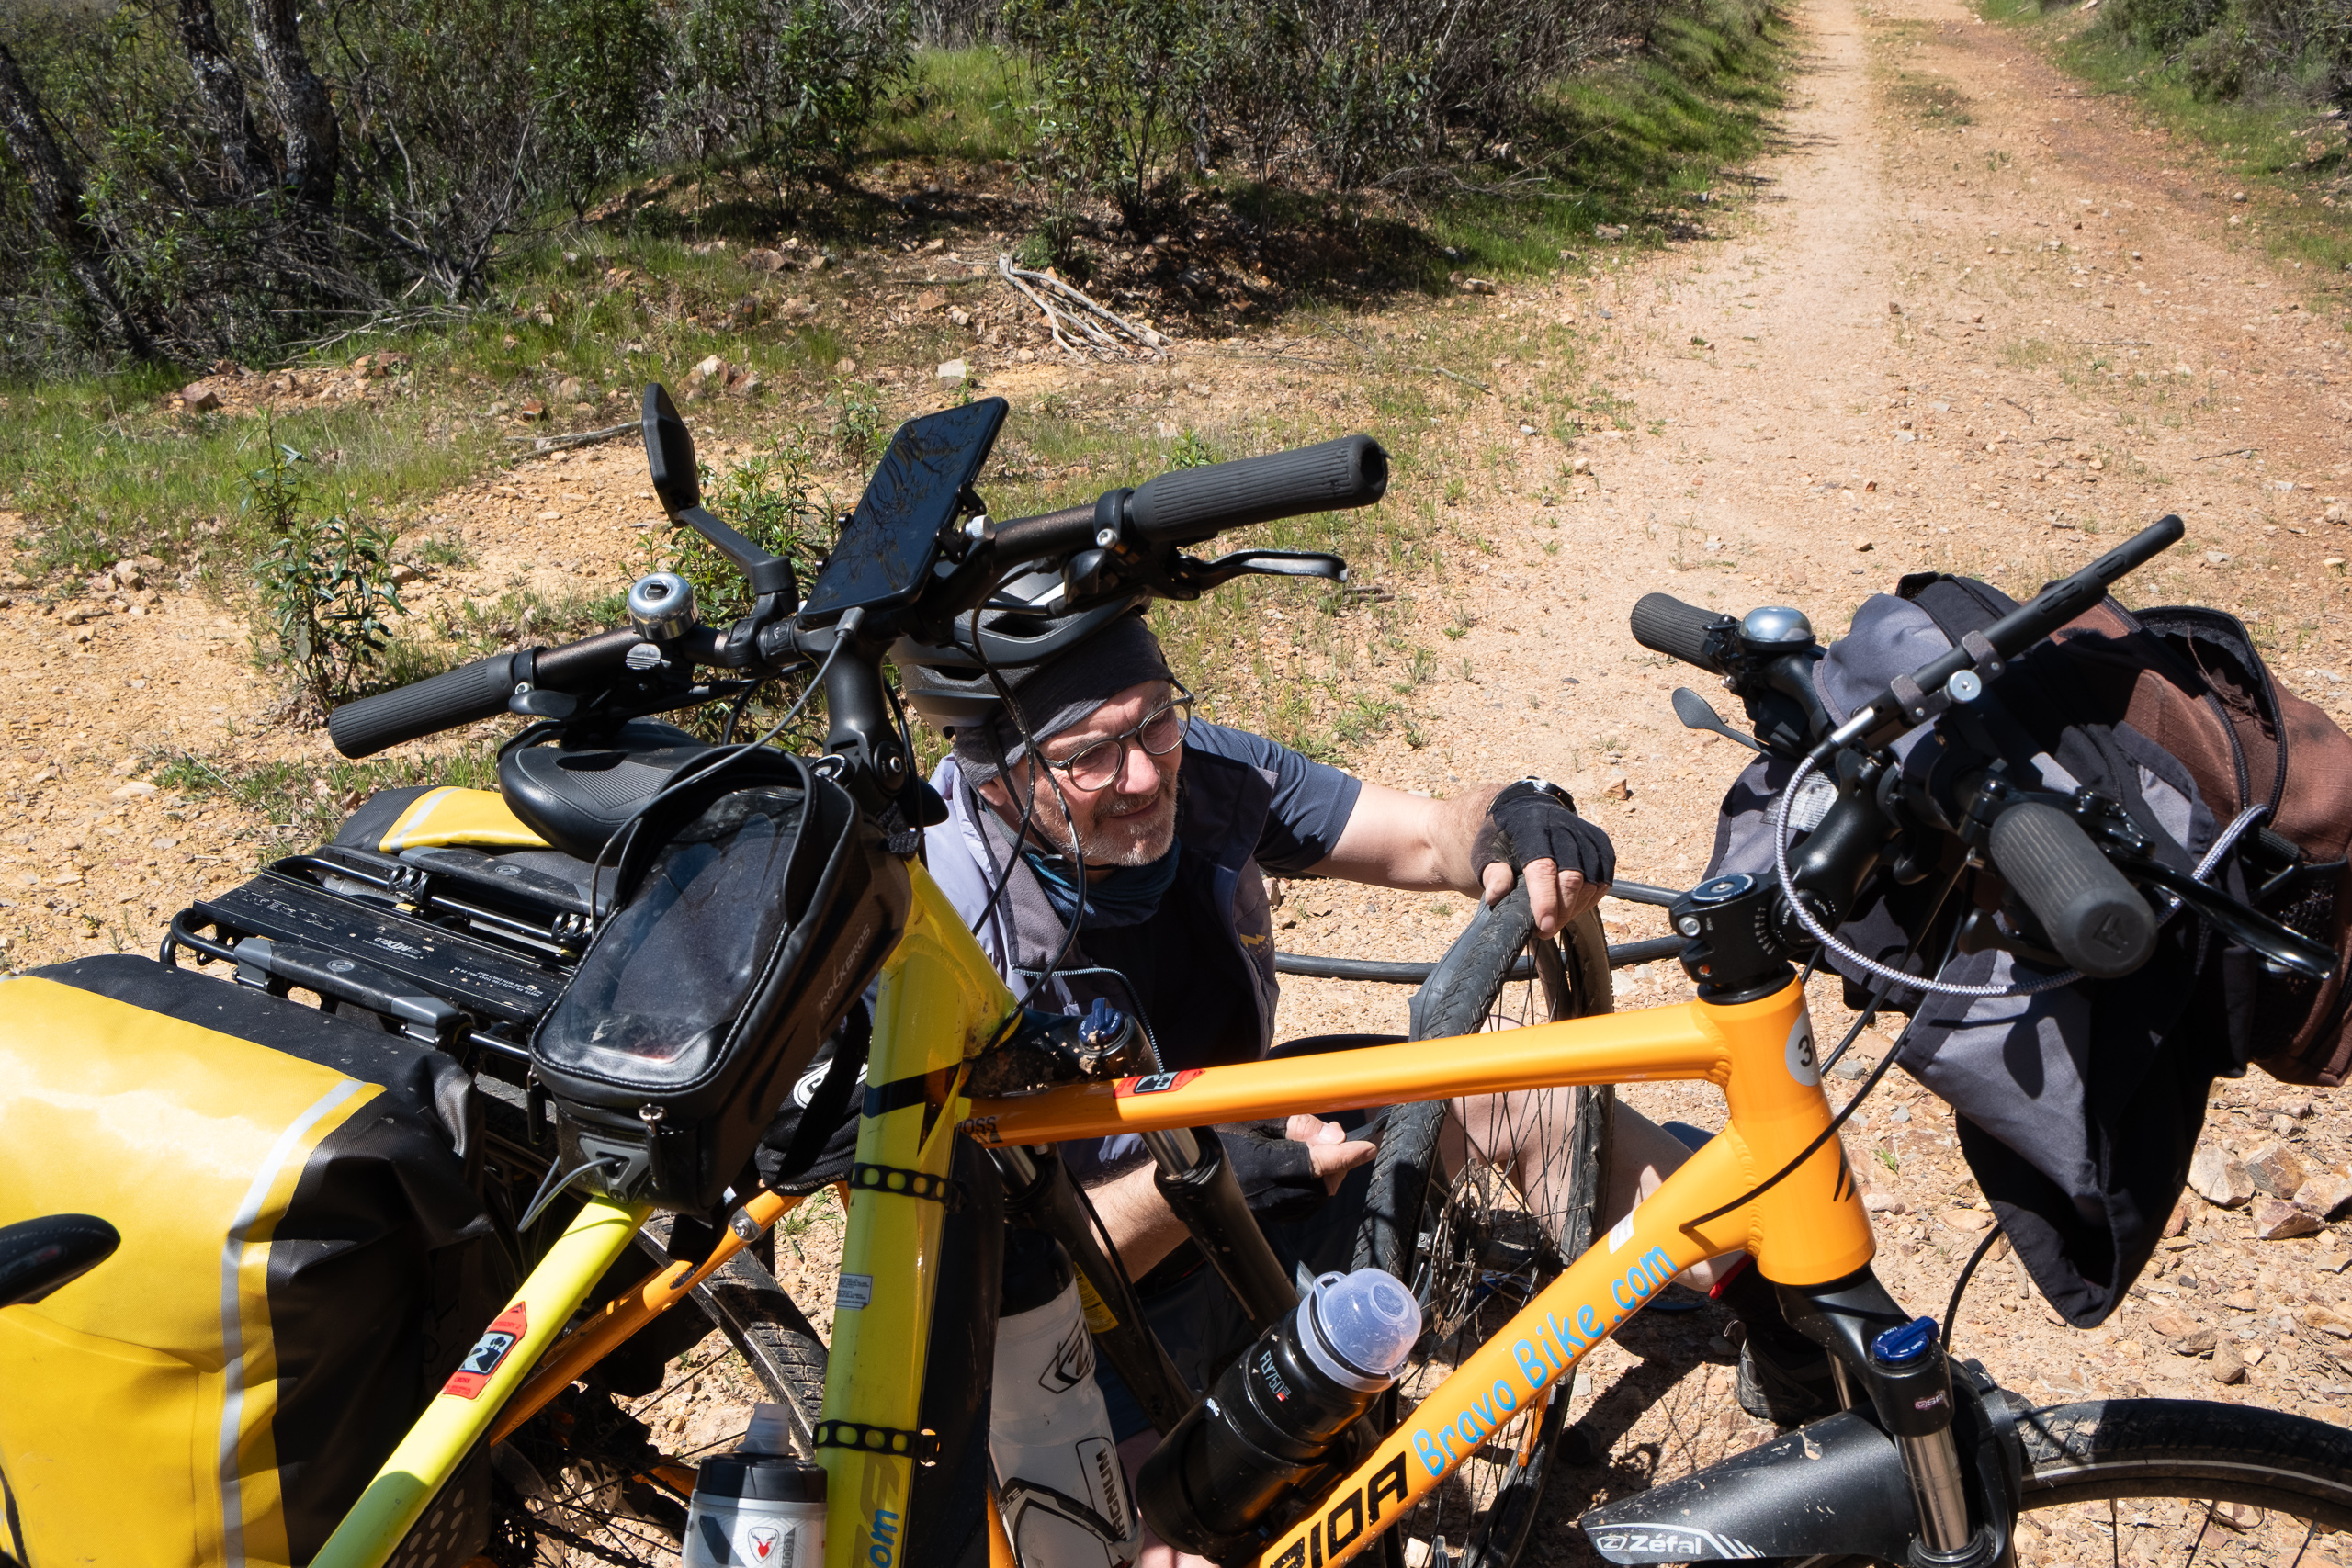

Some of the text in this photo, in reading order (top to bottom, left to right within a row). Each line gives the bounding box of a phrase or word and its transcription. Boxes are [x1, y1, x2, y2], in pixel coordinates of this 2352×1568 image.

[820, 923, 871, 1011] ROCKBROS
[1797, 1035, 1815, 1067] 3
[1412, 1380, 1517, 1478] Bravo
[1630, 1533, 1701, 1555] Zéfal
